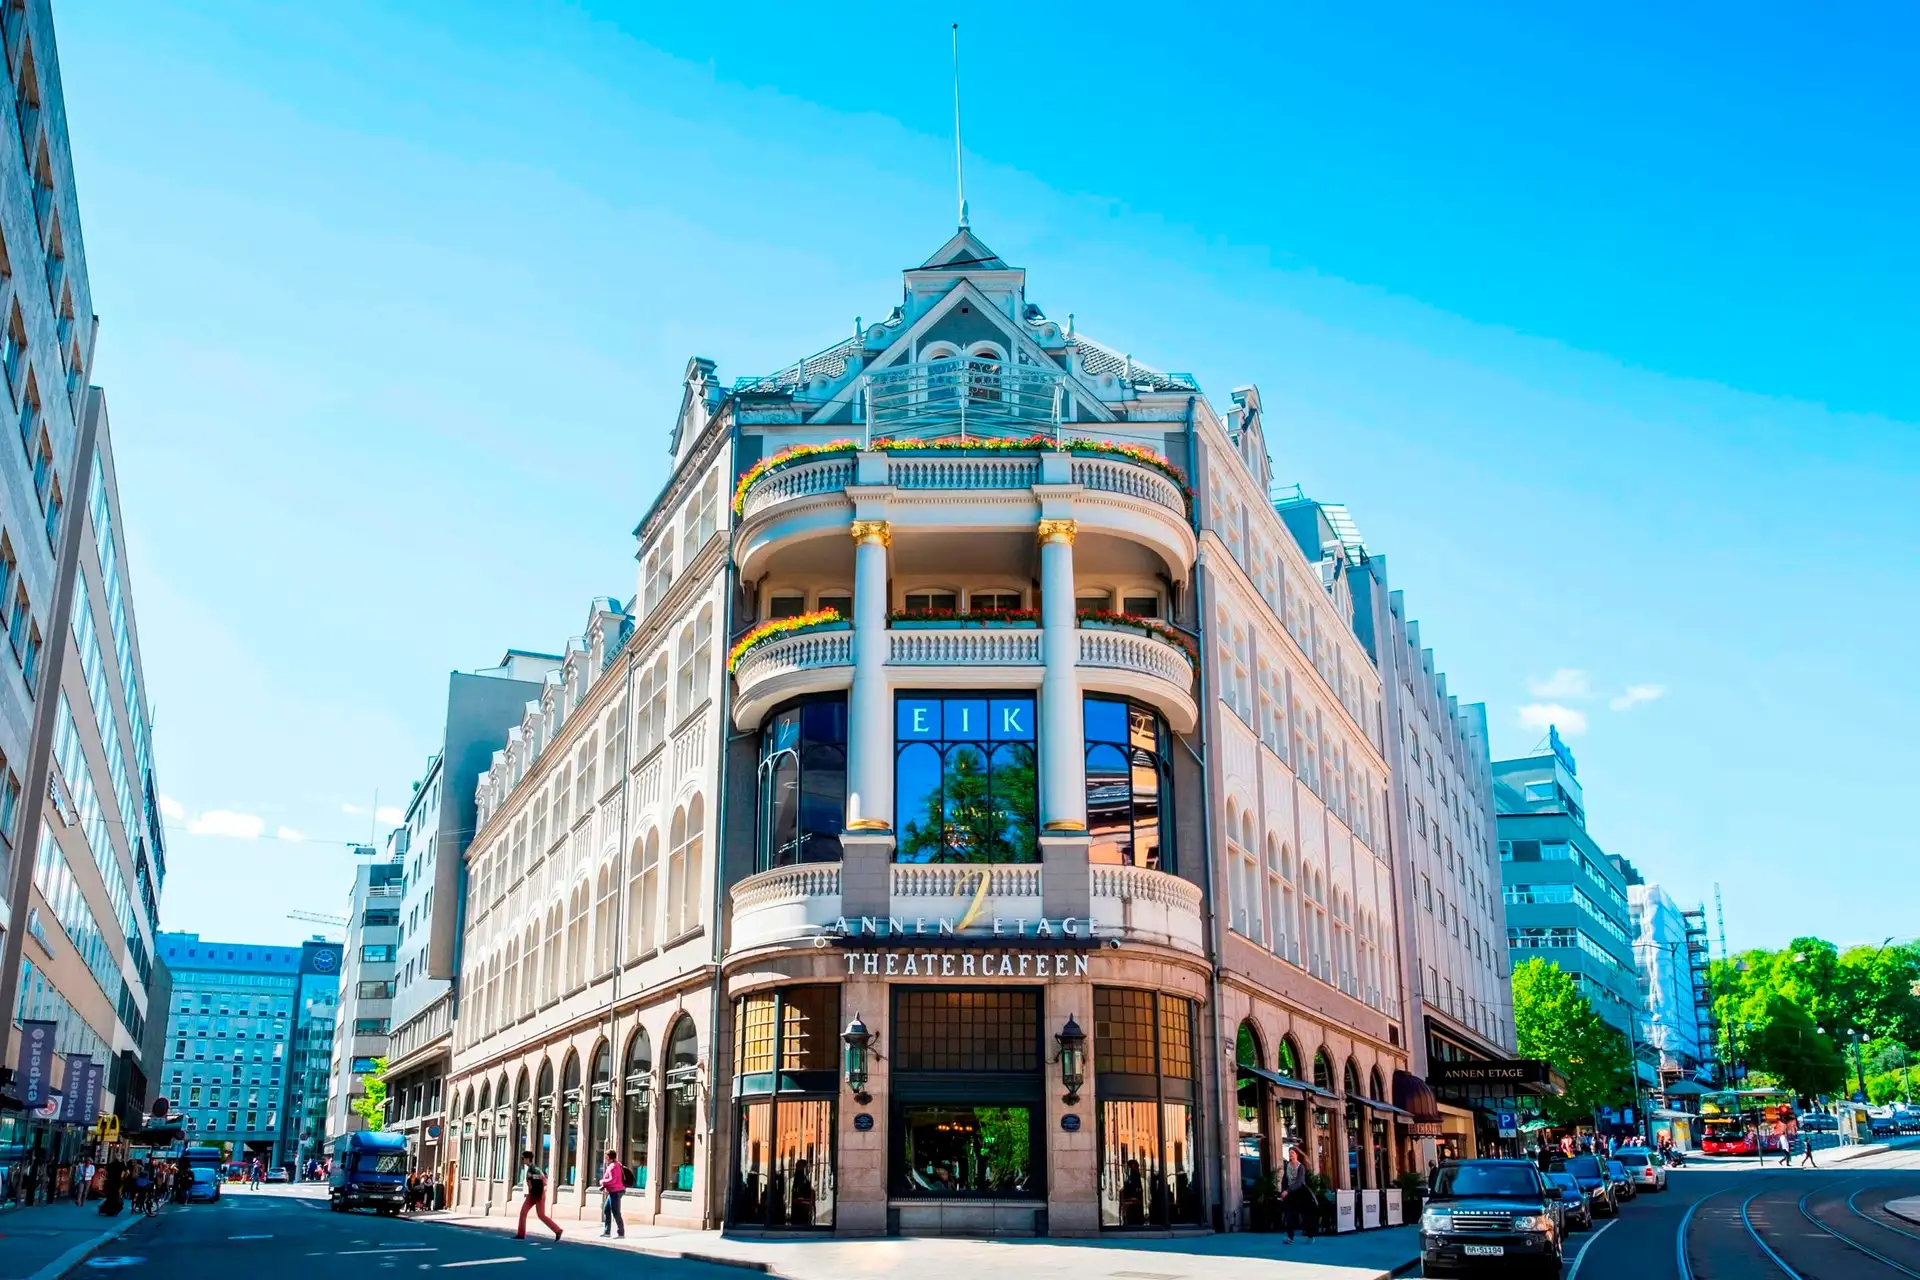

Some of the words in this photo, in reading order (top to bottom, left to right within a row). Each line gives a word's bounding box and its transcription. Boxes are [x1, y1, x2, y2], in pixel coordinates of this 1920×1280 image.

[913, 708, 1024, 732] EIK
[834, 916, 954, 933] ANNEN
[993, 917, 1099, 934] ETAGE
[843, 953, 1090, 976] THEATERCAFEEN
[27, 1041, 42, 1101] expert
[1445, 1070, 1485, 1078] ANNEN
[1488, 1069, 1524, 1077] ETAGE
[66, 1070, 81, 1117] expert
[84, 1079, 95, 1121] expert
[1501, 1114, 1511, 1127] P
